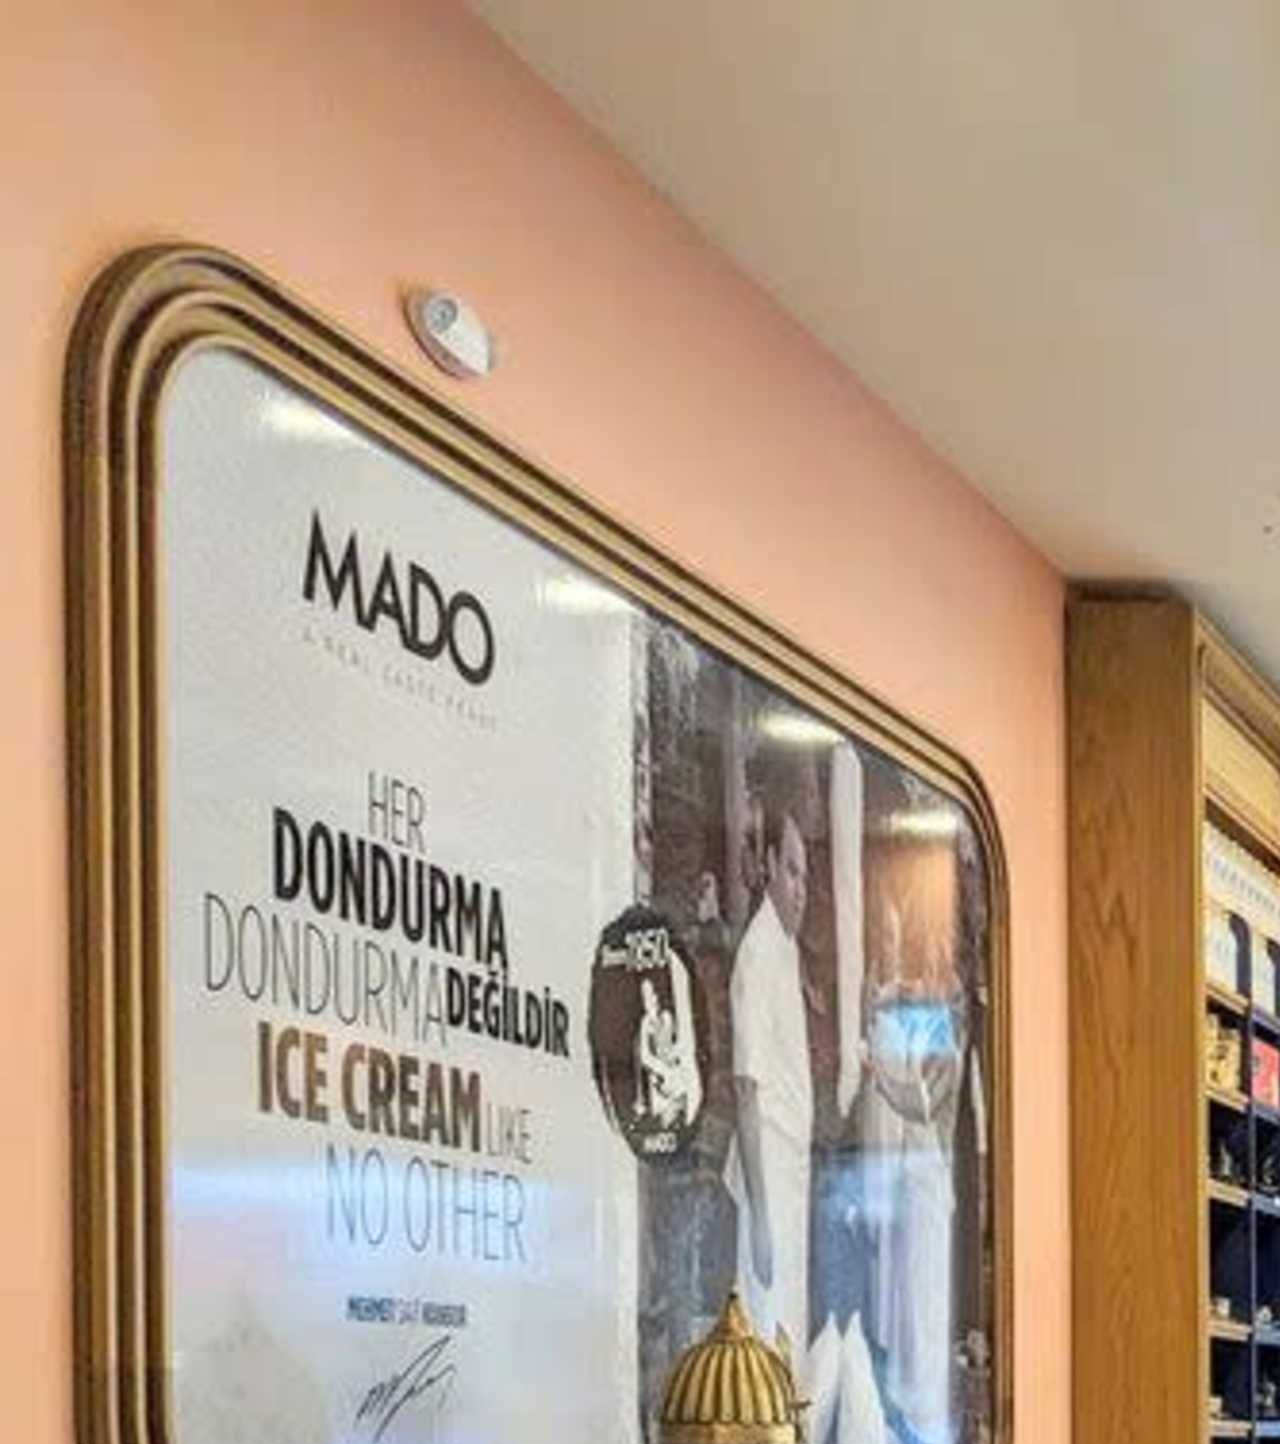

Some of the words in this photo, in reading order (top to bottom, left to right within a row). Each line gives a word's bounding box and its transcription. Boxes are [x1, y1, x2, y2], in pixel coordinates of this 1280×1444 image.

[302, 508, 495, 686] MADO
[368, 770, 426, 853] HER
[273, 806, 509, 970] DONDURMA
[205, 892, 448, 1049] DONDURMA
[257, 1020, 329, 1124] ICE
[340, 1043, 483, 1153] CREAM
[485, 1101, 534, 1165] LIKE
[326, 1142, 390, 1246] NO
[402, 1155, 528, 1263] OTHER
